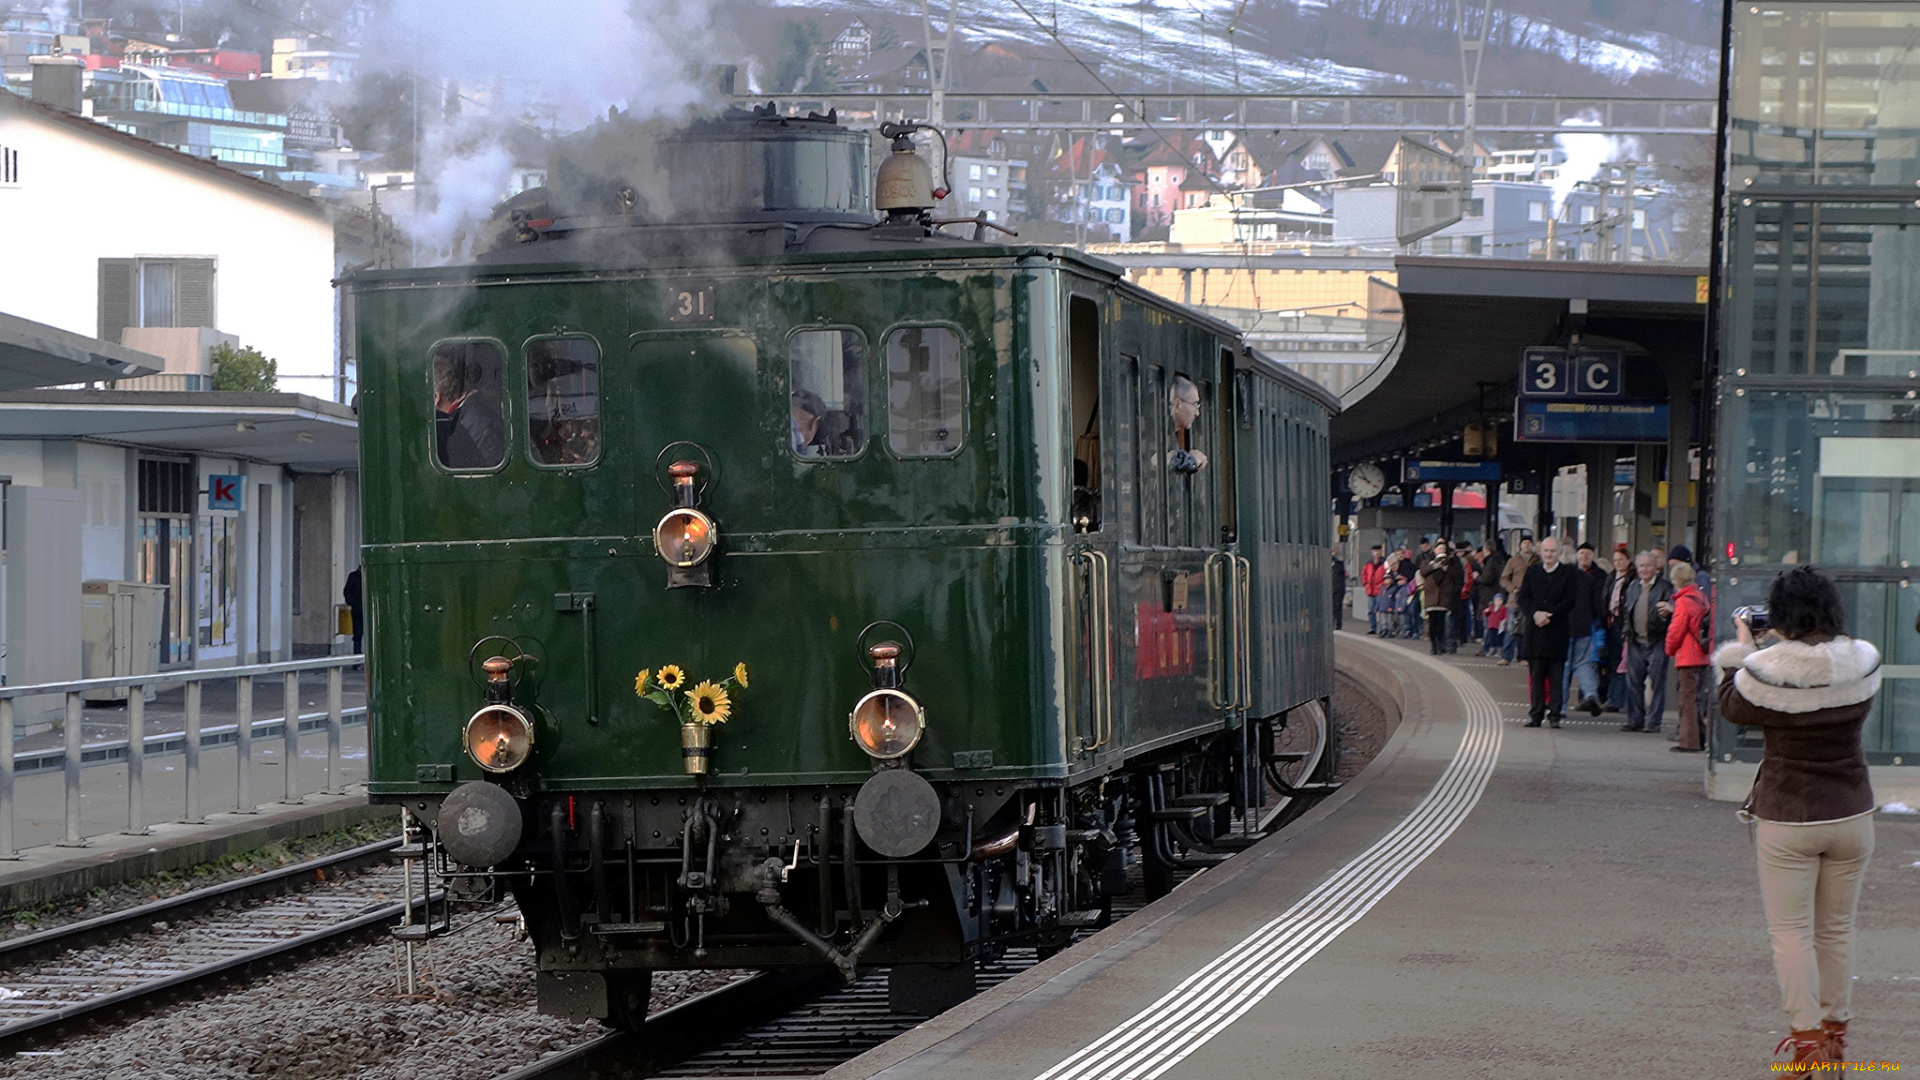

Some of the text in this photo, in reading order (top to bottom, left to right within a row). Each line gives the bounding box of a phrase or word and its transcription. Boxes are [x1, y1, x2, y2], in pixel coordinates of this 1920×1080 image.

[678, 291, 704, 316] 31
[1535, 362, 1556, 390] 3
[1586, 362, 1610, 390] C
[1530, 419, 1539, 431] 3
[1513, 479, 1524, 491] B
